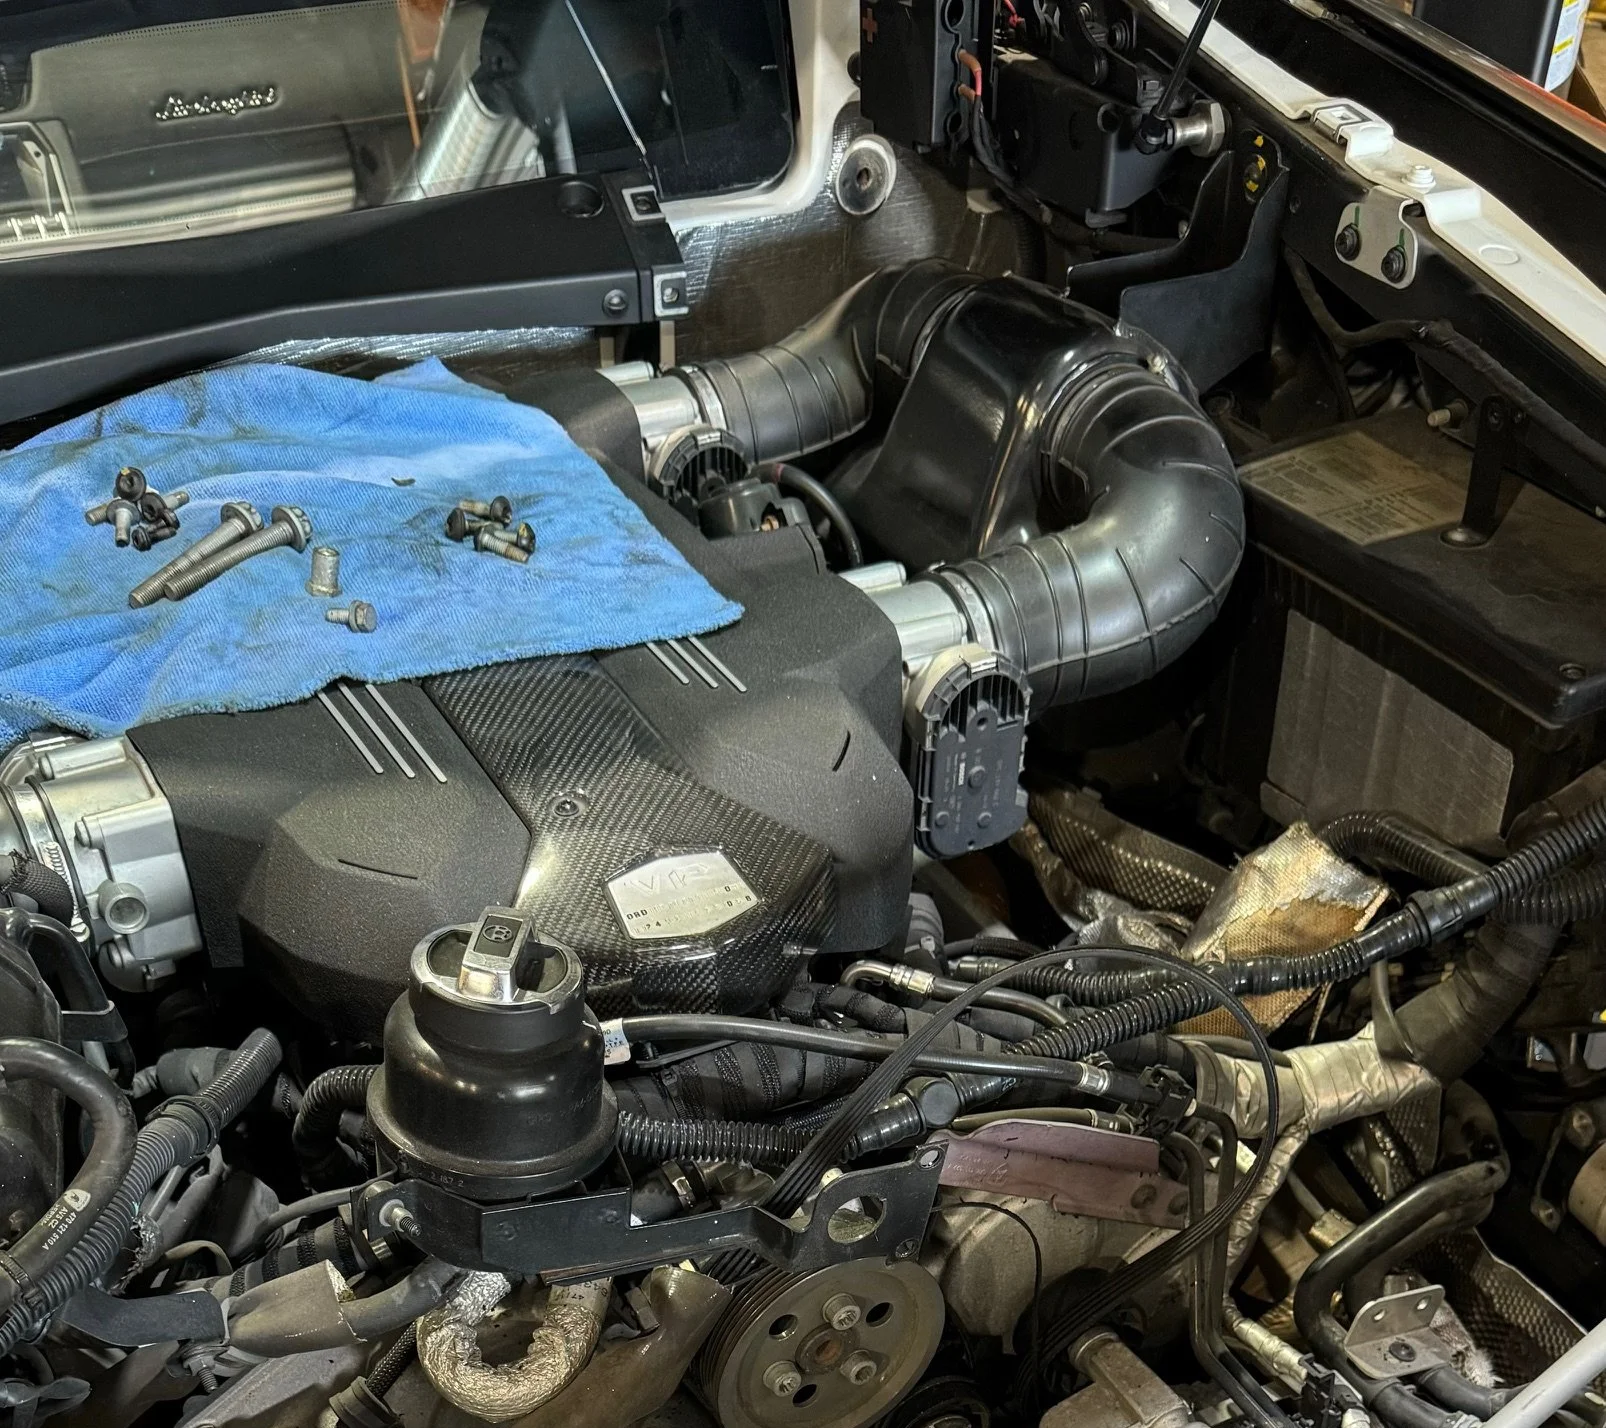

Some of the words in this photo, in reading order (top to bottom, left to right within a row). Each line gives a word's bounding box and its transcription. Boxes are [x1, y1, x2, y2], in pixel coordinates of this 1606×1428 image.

[65, 1211, 77, 1225] 470
[56, 1222, 68, 1235] 121
[47, 1232, 60, 1246] 510
[42, 1242, 49, 1251] A
